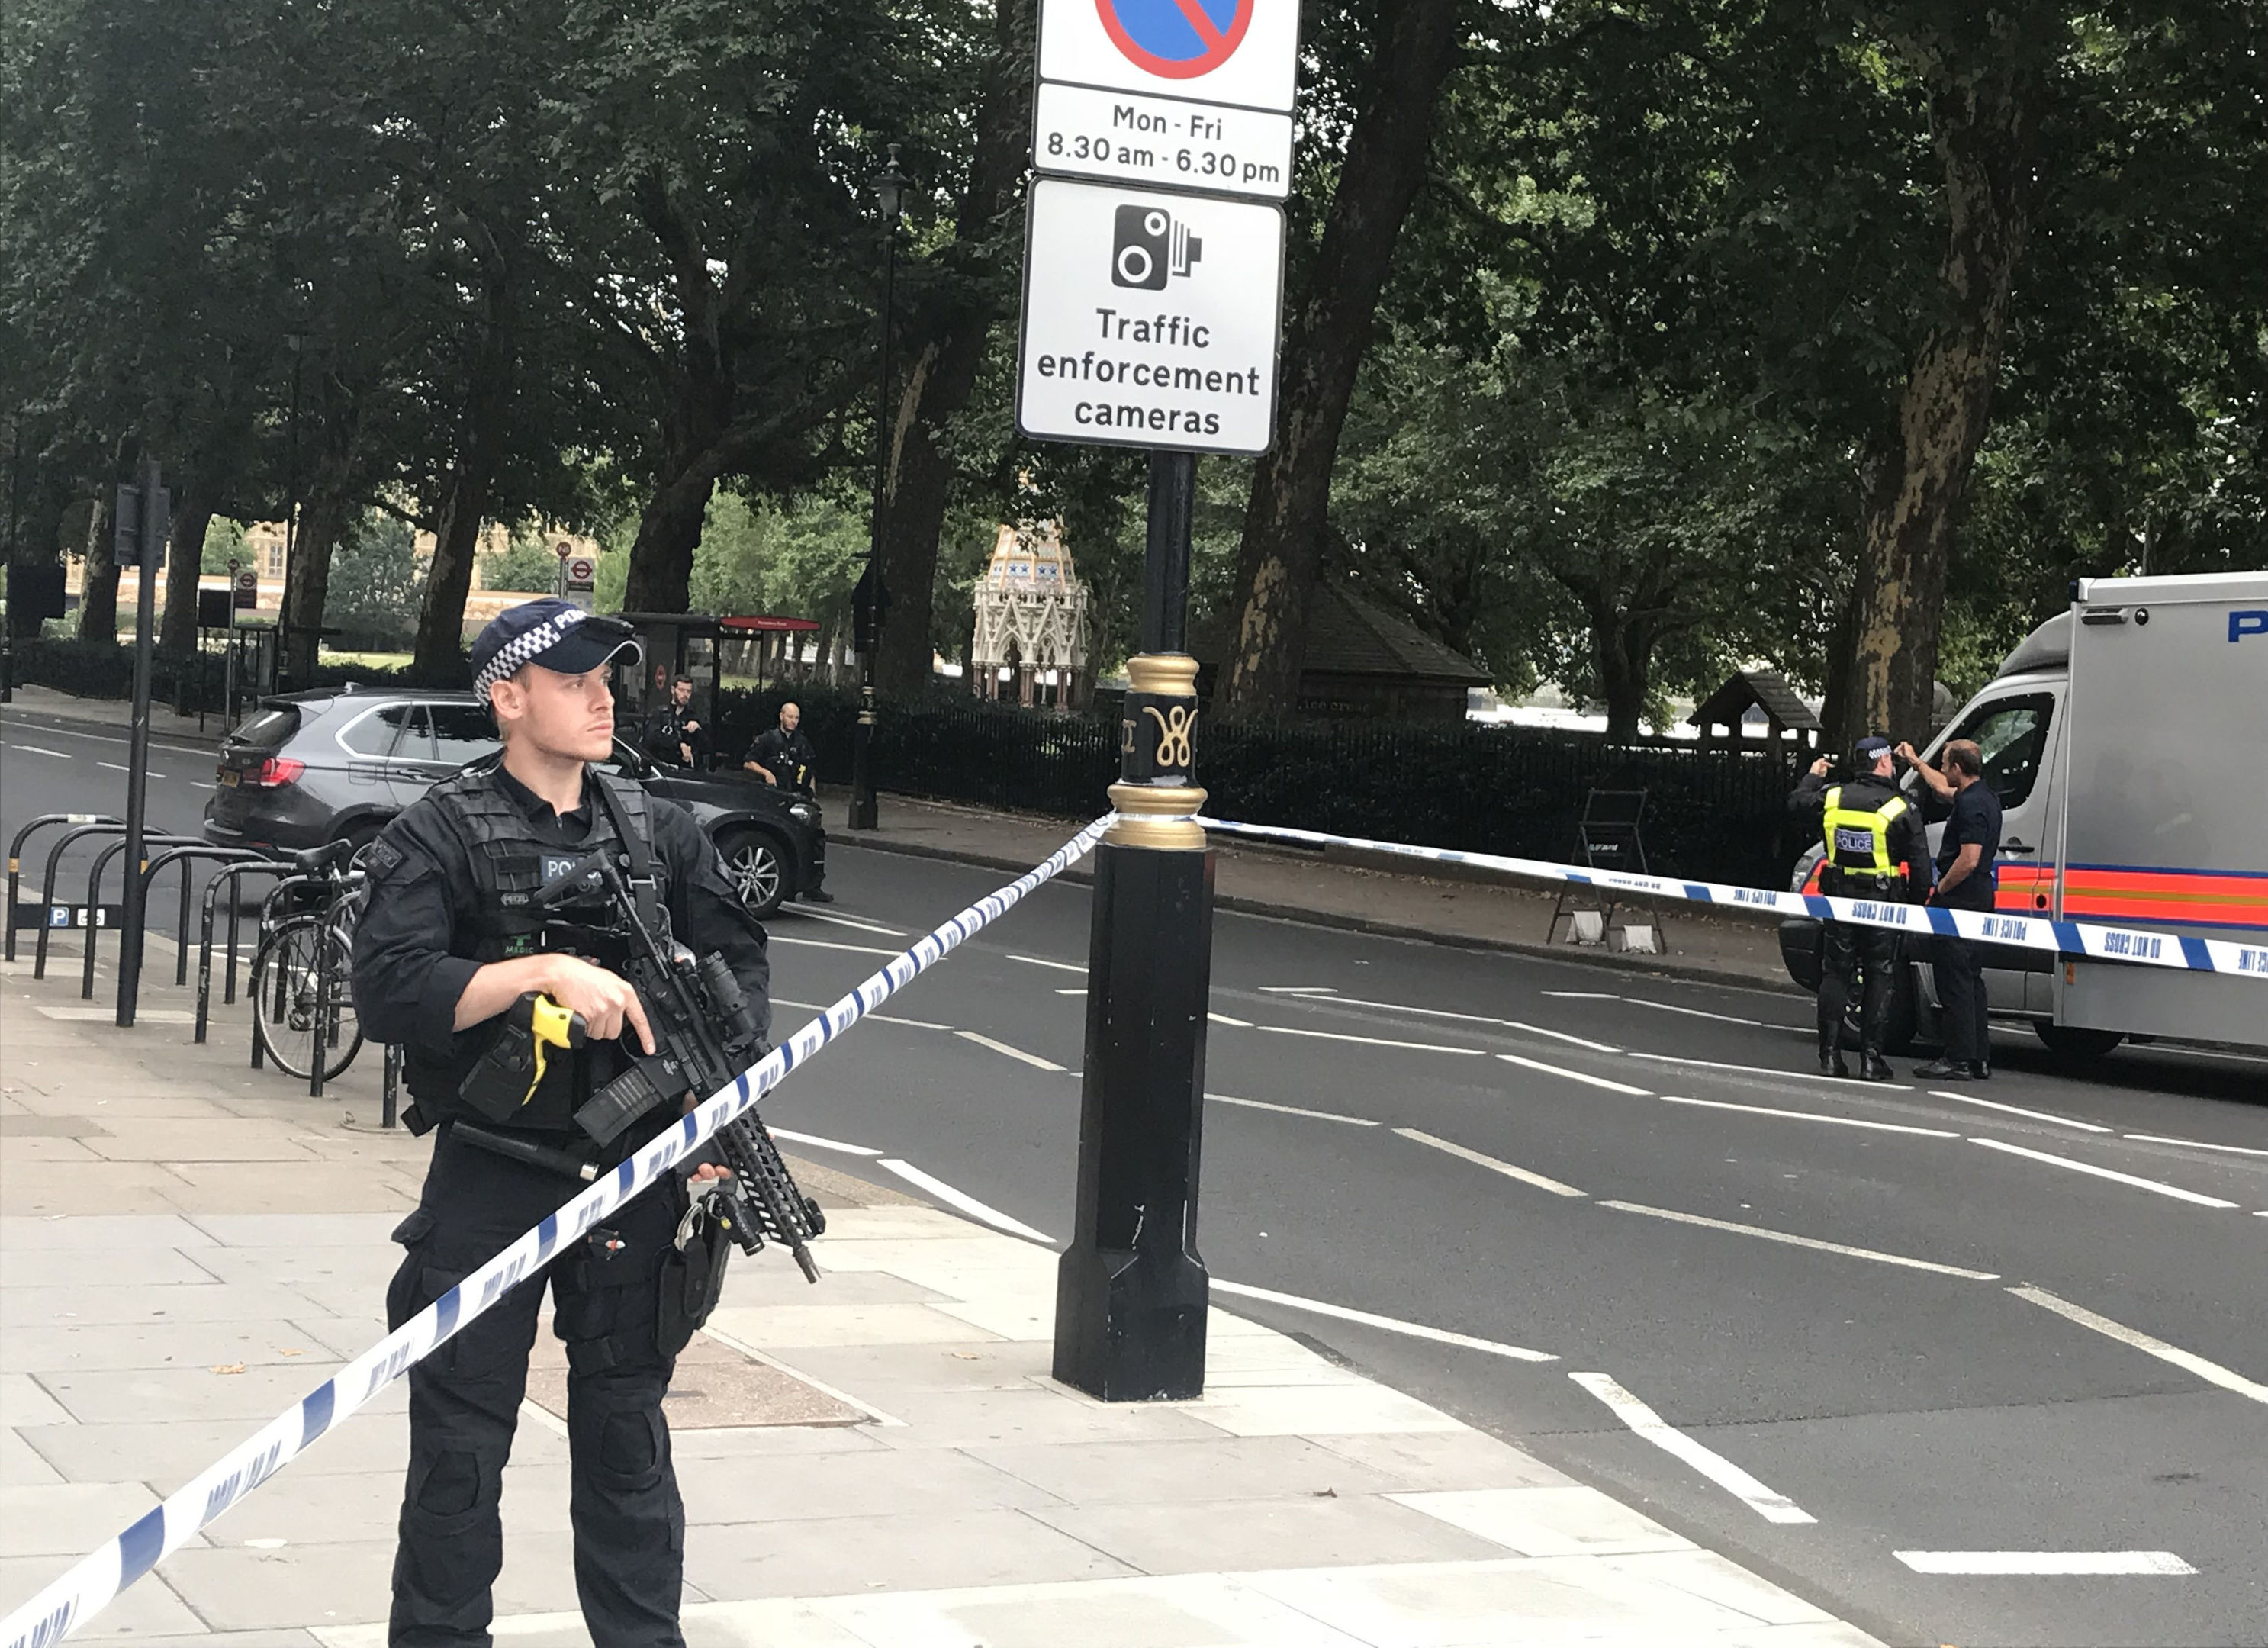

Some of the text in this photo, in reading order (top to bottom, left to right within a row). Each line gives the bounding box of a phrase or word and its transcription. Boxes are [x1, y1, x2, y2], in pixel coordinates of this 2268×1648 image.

[1114, 105, 1166, 133] Mon
[1191, 115, 1221, 140] Fri
[1048, 132, 1110, 161] 8.30
[1118, 146, 1153, 166] am
[1177, 149, 1236, 176] 6.30
[1243, 163, 1279, 182] pm
[1095, 307, 1210, 349] Traffic
[1037, 351, 1260, 396] enforcement
[1075, 402, 1220, 435] cameras
[1836, 835, 1872, 850] POLICE
[53, 909, 66, 924] P
[1852, 901, 1907, 924] DO NOT CROSS
[1981, 916, 2027, 941] POLICE LINE
[2104, 932, 2162, 959] DO NOT CROSS
[2238, 949, 2256, 970] LINE
